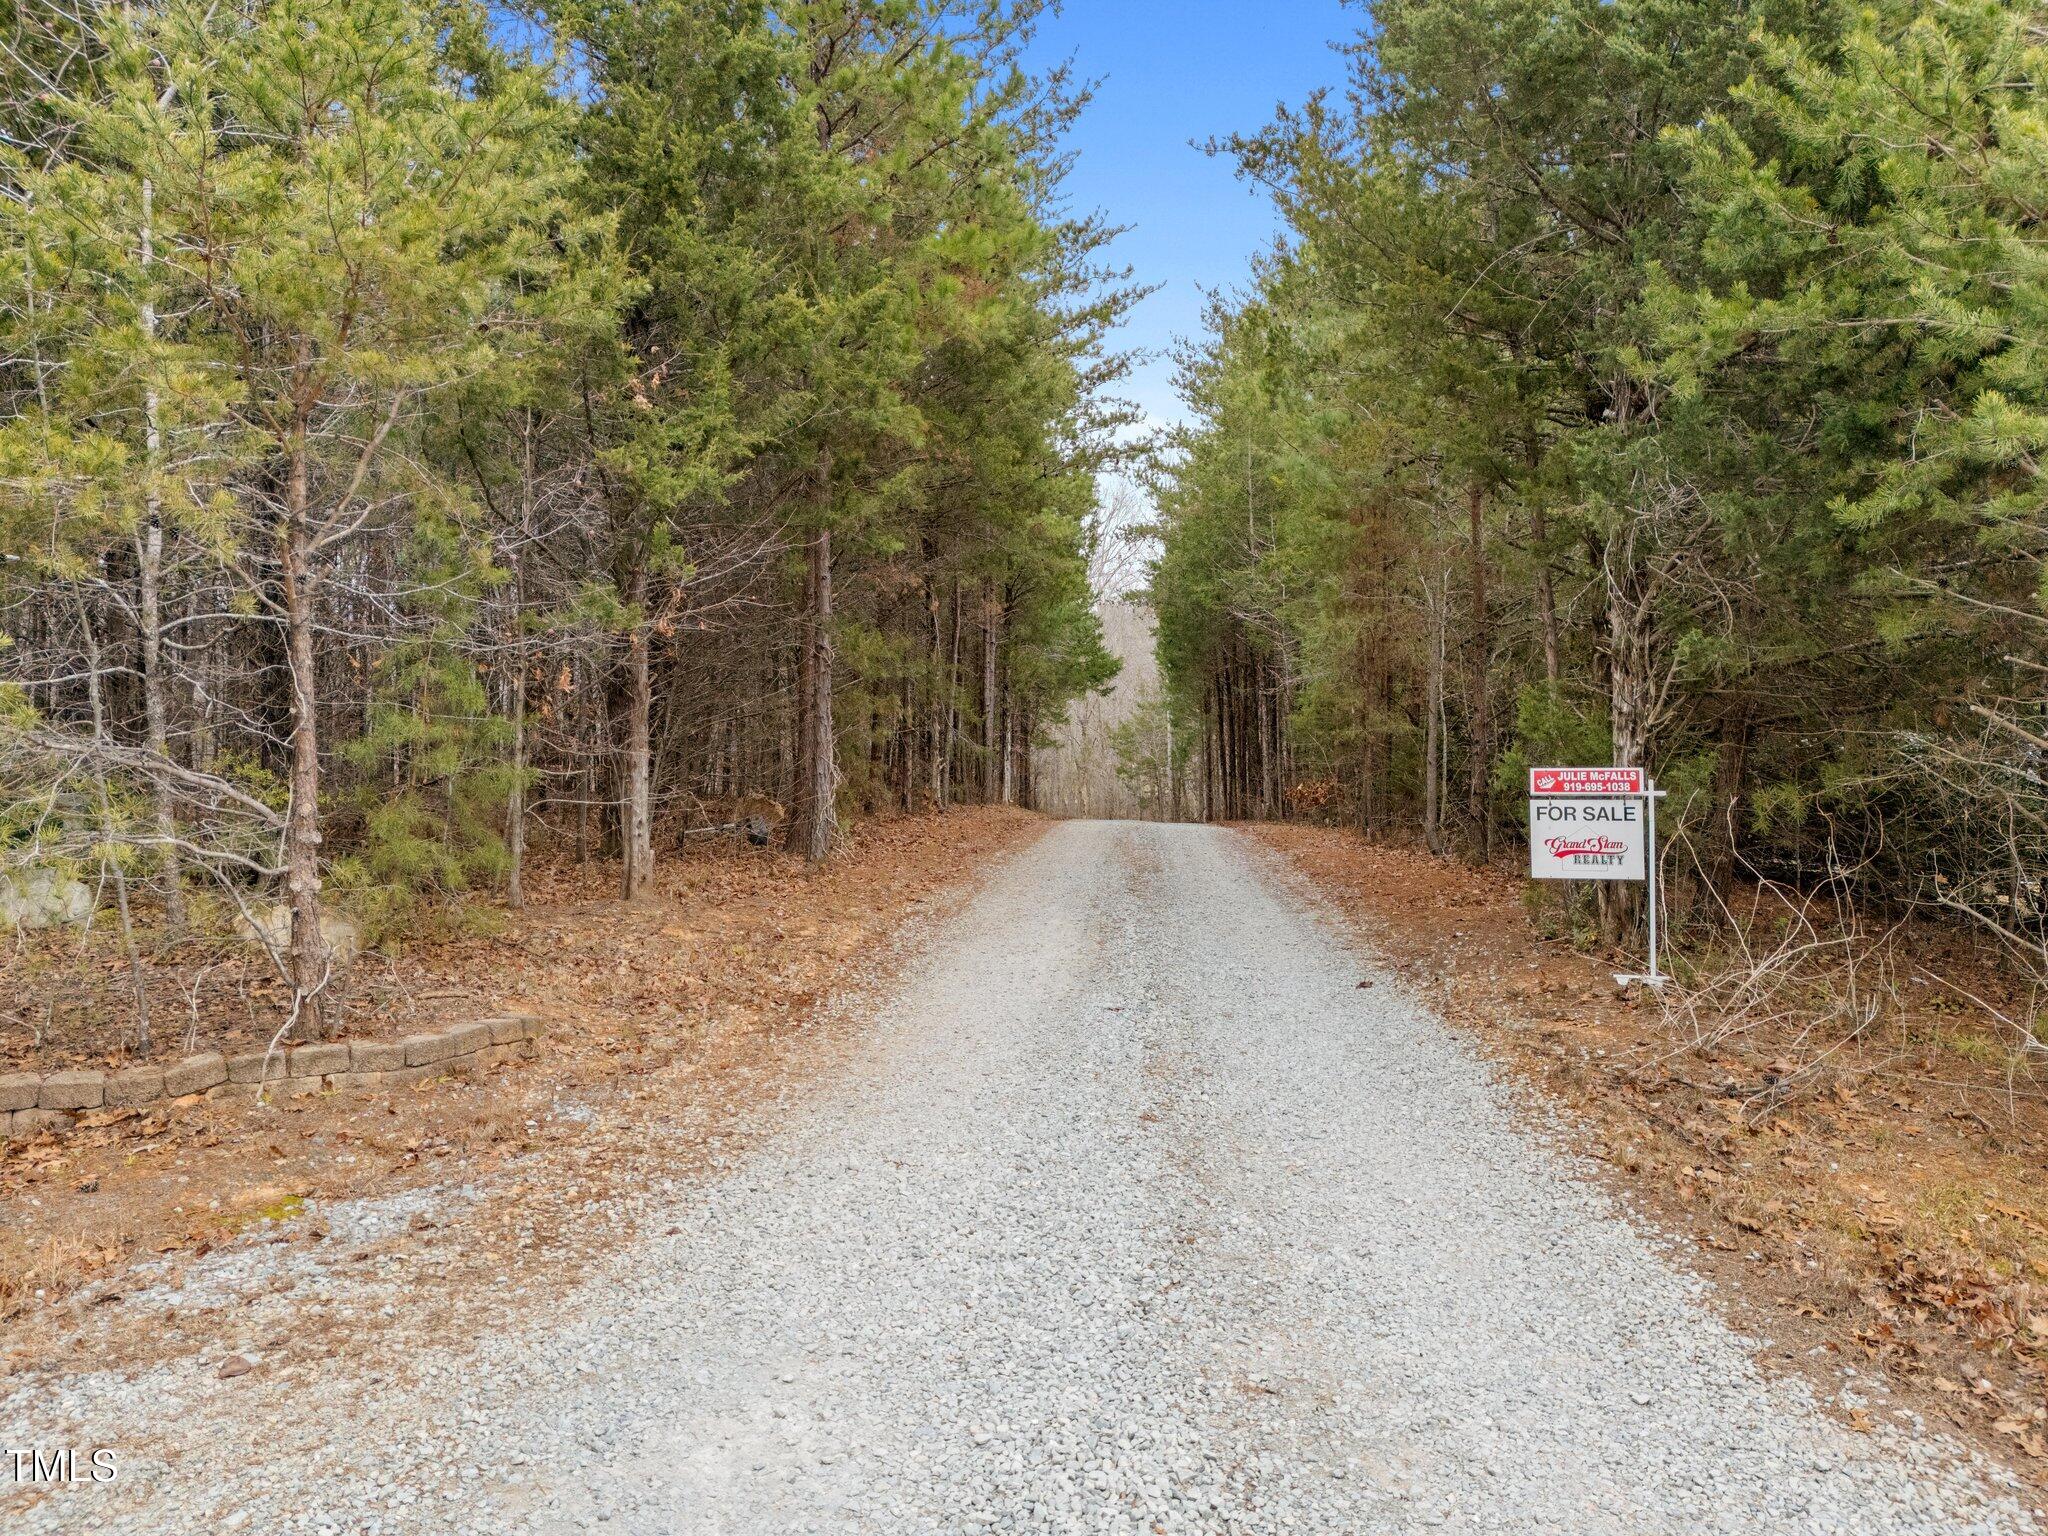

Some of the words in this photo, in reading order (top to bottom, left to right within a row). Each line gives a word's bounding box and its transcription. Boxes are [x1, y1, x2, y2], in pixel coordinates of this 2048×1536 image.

[1537, 774, 1555, 787] CALL
[1557, 771, 1587, 781] JULIE
[1590, 771, 1637, 781] McFALLS
[1563, 782, 1631, 791] 919-695-1038
[1536, 806, 1577, 821] FOR
[1582, 806, 1636, 821] SALE
[1544, 835, 1587, 854] Grand
[1587, 835, 1624, 853] Slam
[1573, 855, 1625, 866] REALTY
